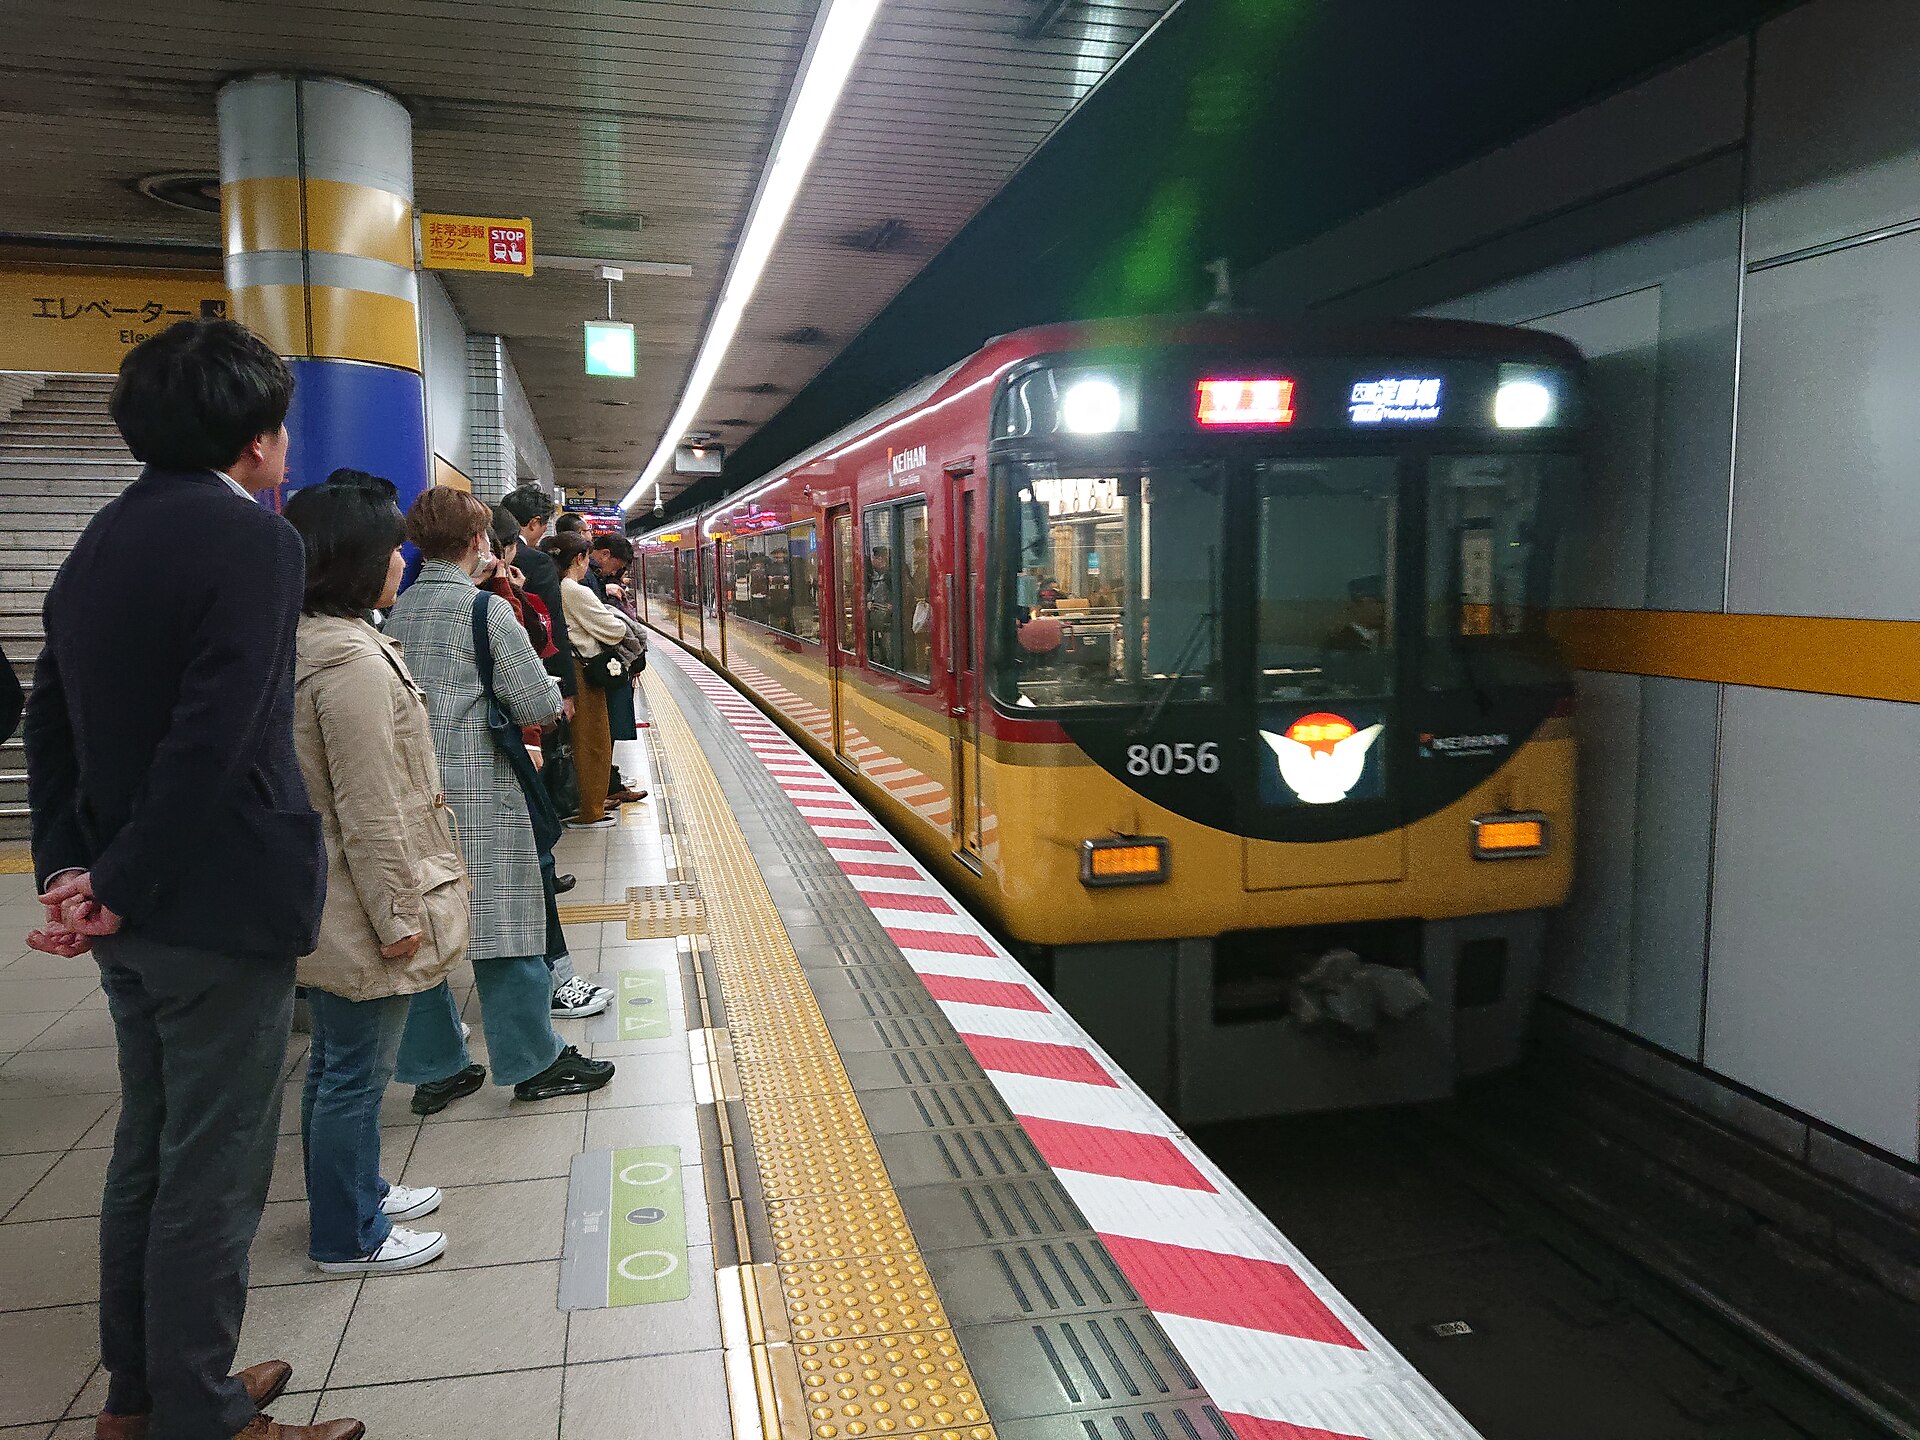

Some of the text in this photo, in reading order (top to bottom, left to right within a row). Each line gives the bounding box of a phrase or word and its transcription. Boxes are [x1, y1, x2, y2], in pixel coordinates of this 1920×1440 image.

[429, 223, 485, 239] 非常通報
[491, 229, 524, 241] STOP
[430, 236, 469, 250] ボタン
[32, 297, 192, 323] エレベーター
[892, 445, 927, 474] KEIHAN
[1126, 741, 1221, 776] 8056
